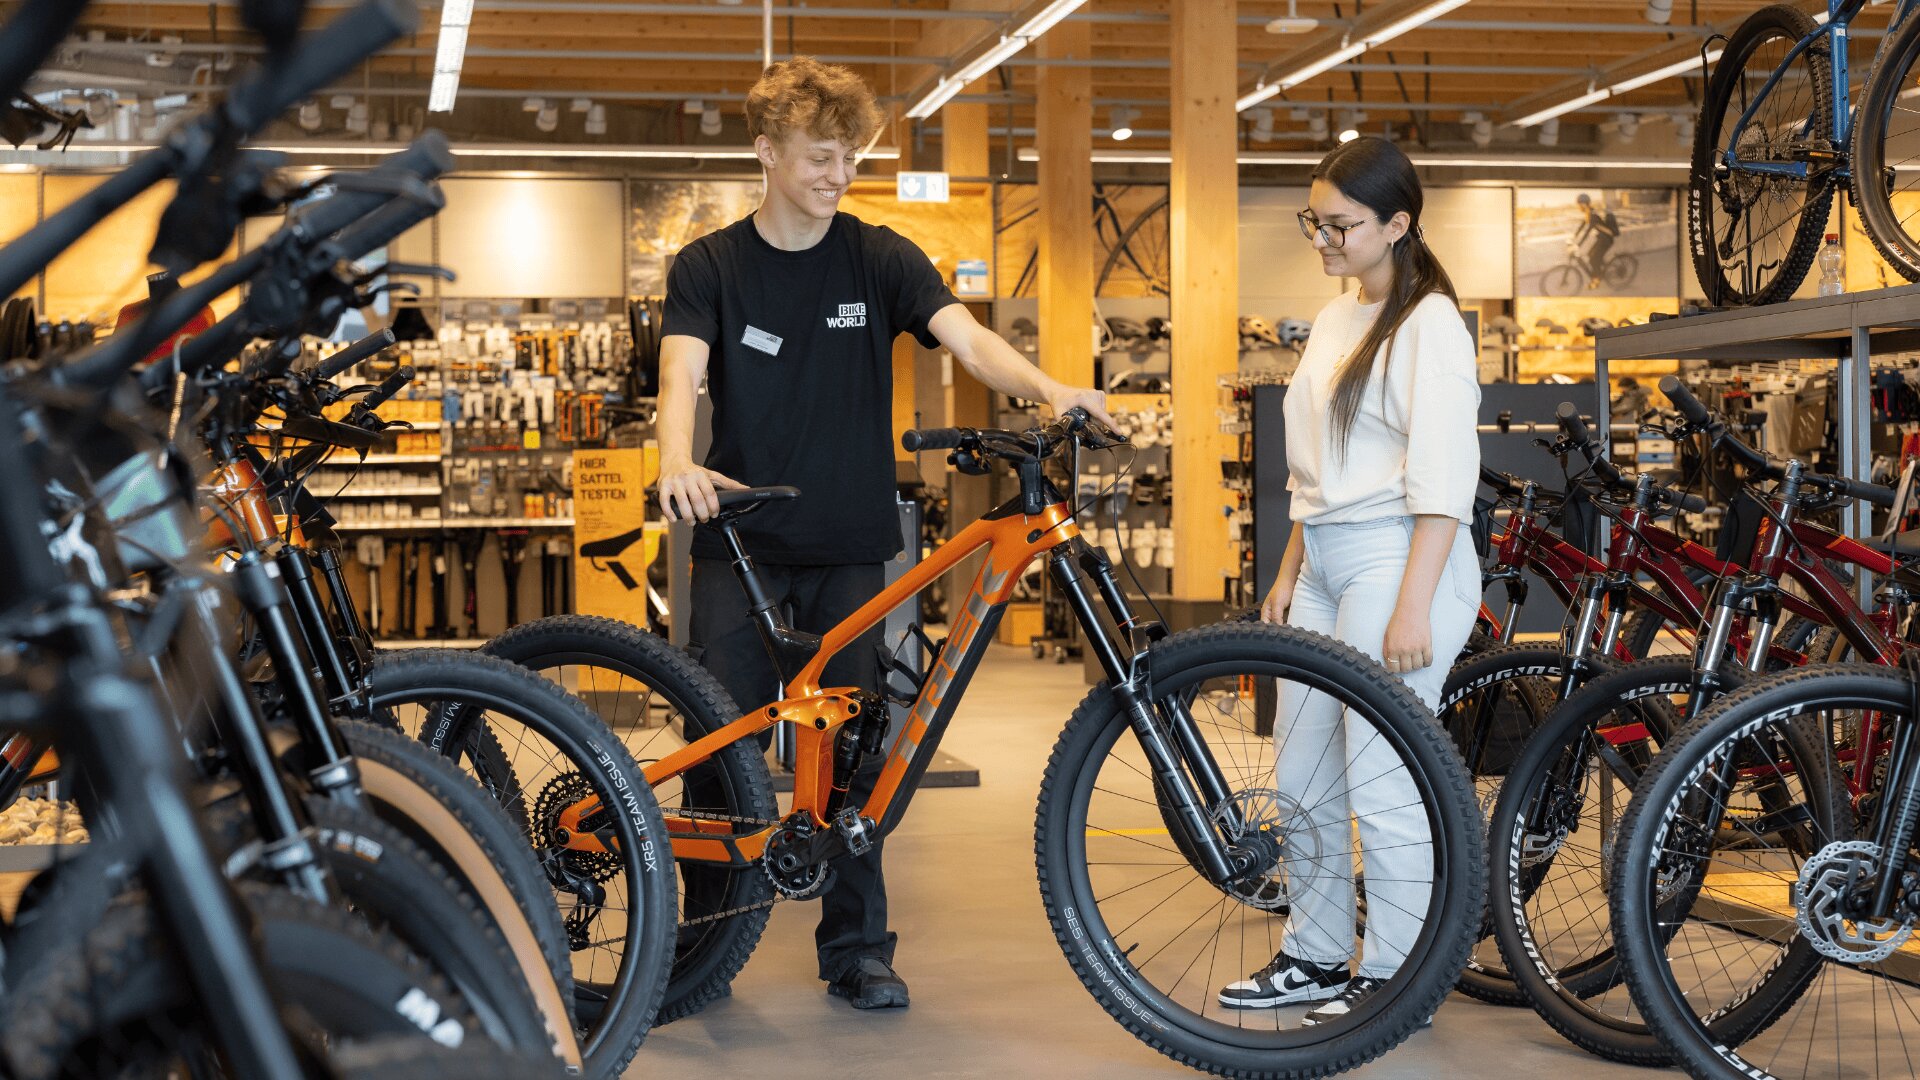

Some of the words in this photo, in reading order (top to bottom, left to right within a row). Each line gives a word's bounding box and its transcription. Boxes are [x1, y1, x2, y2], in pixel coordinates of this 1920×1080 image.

[1692, 189, 1705, 256] MAXXIS
[826, 316, 866, 328] WORLD
[839, 303, 866, 316] BIKE
[579, 458, 606, 469] HIER
[580, 473, 624, 485] SATTEL
[580, 489, 626, 501] TESTEN
[888, 561, 1009, 769] TREK
[598, 752, 629, 792] ISSUE
[622, 791, 649, 836] TEAM
[641, 840, 658, 872] XR5
[1081, 943, 1114, 987] TEAM
[1111, 985, 1153, 1024] ISSUE
